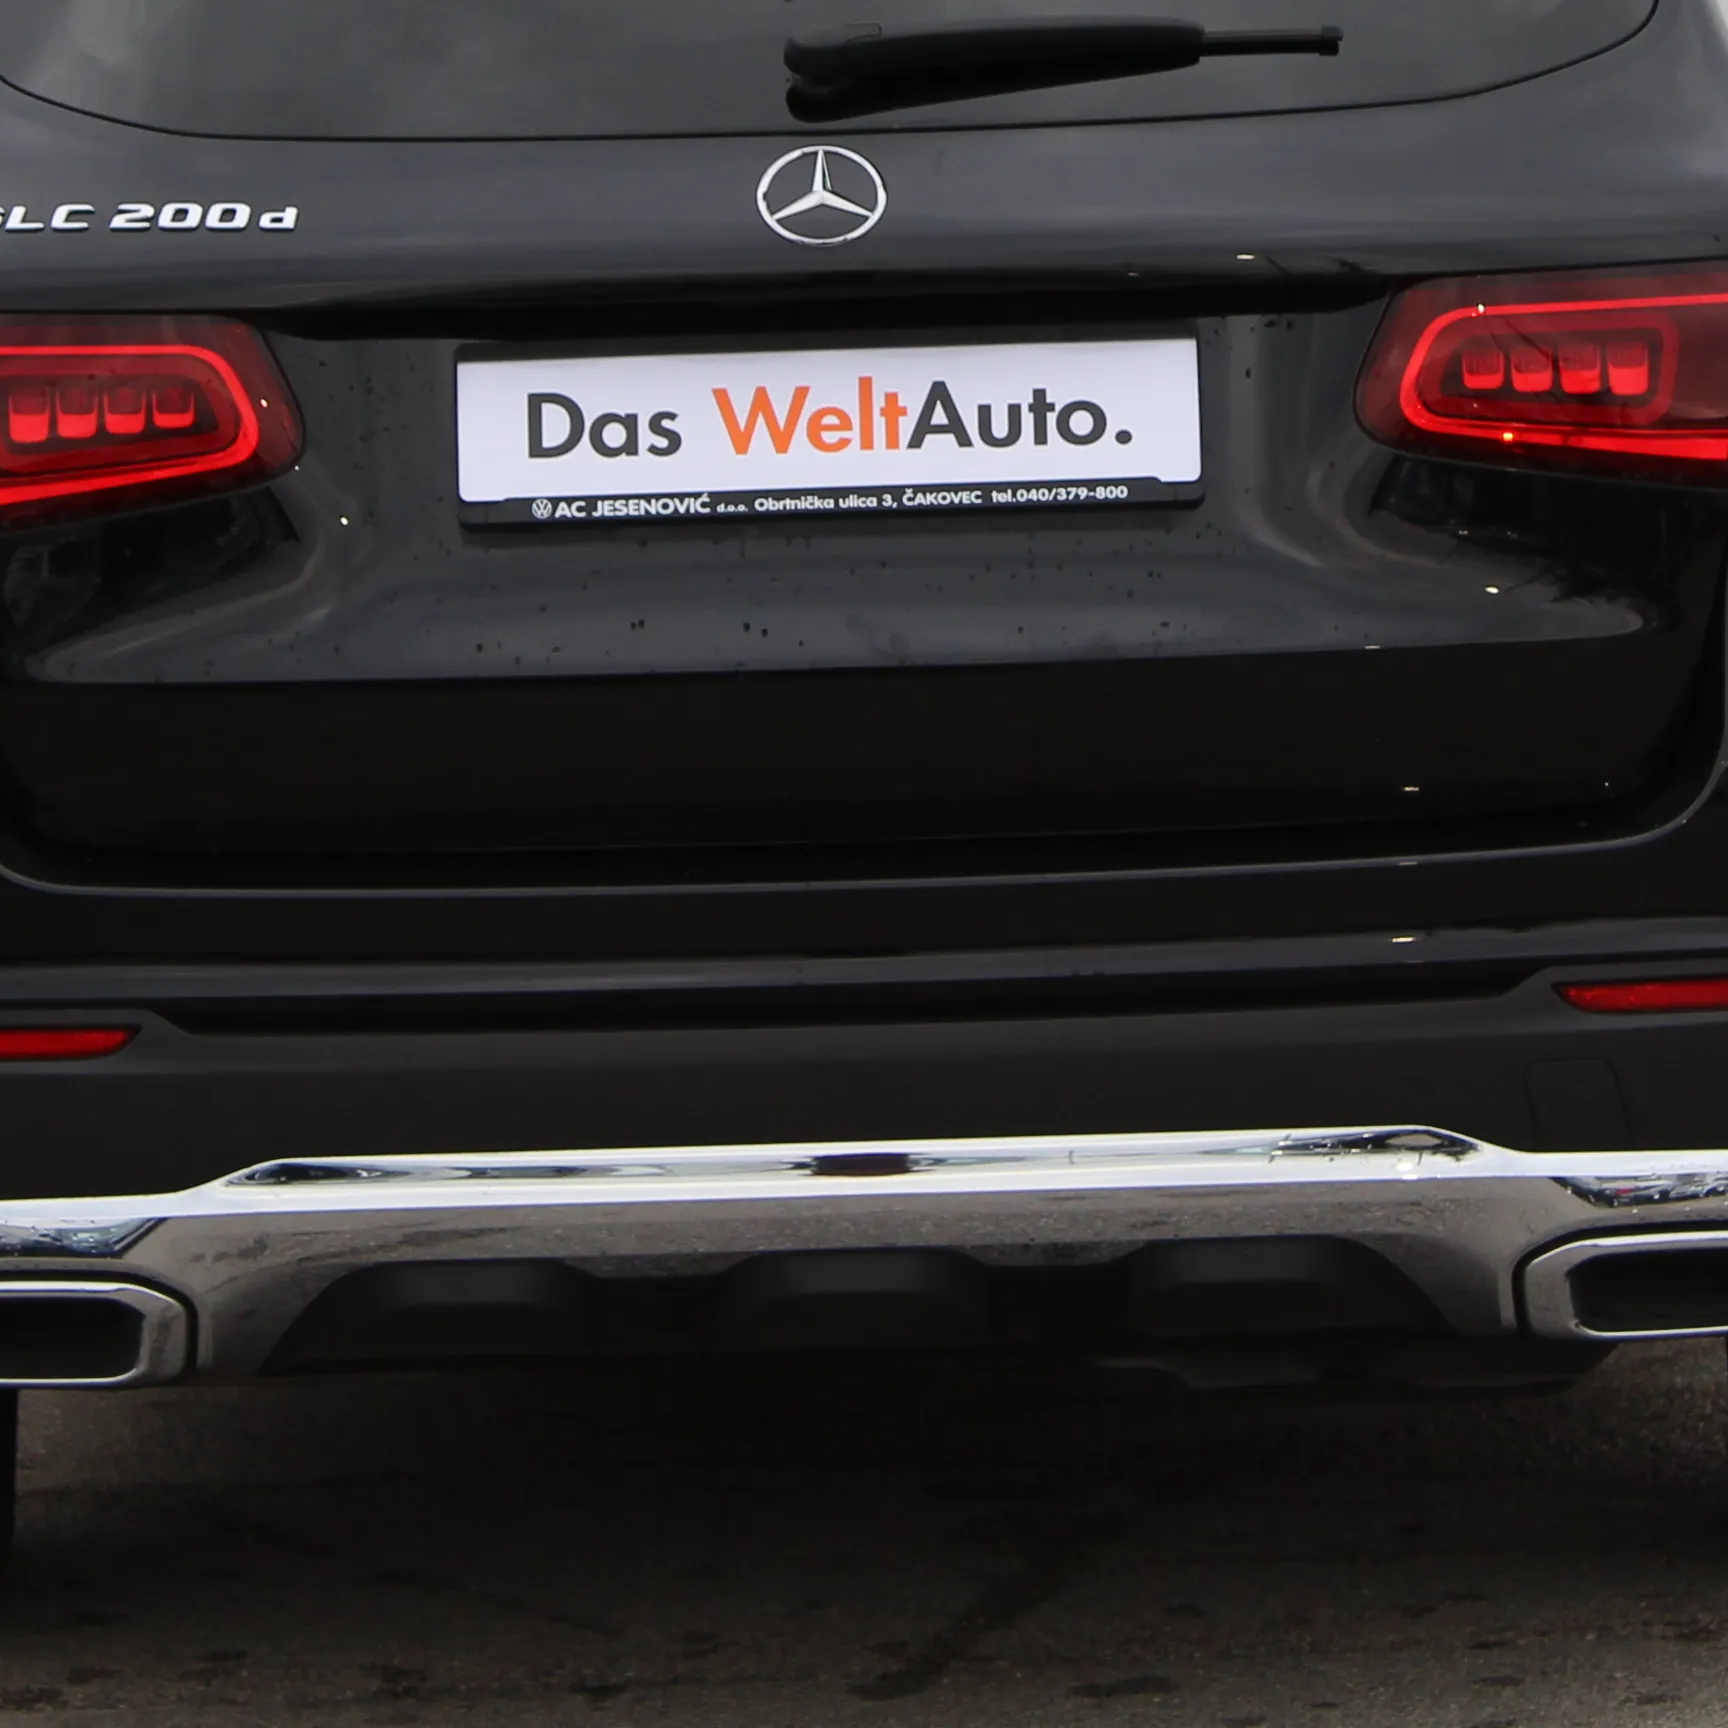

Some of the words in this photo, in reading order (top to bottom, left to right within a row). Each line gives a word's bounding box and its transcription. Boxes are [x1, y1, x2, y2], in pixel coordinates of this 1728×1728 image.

[526, 391, 683, 460] Das
[711, 375, 1134, 457] WeltAuto.
[554, 500, 587, 519] AC
[591, 492, 712, 518] JESENOVIĆ
[716, 502, 749, 513] d.o.o.
[754, 493, 836, 512] Obrtnička
[838, 492, 878, 509] ulica
[881, 493, 898, 510] 3,
[902, 487, 983, 506] ČAKOVEC
[990, 484, 1129, 503] tel.040/379-800
